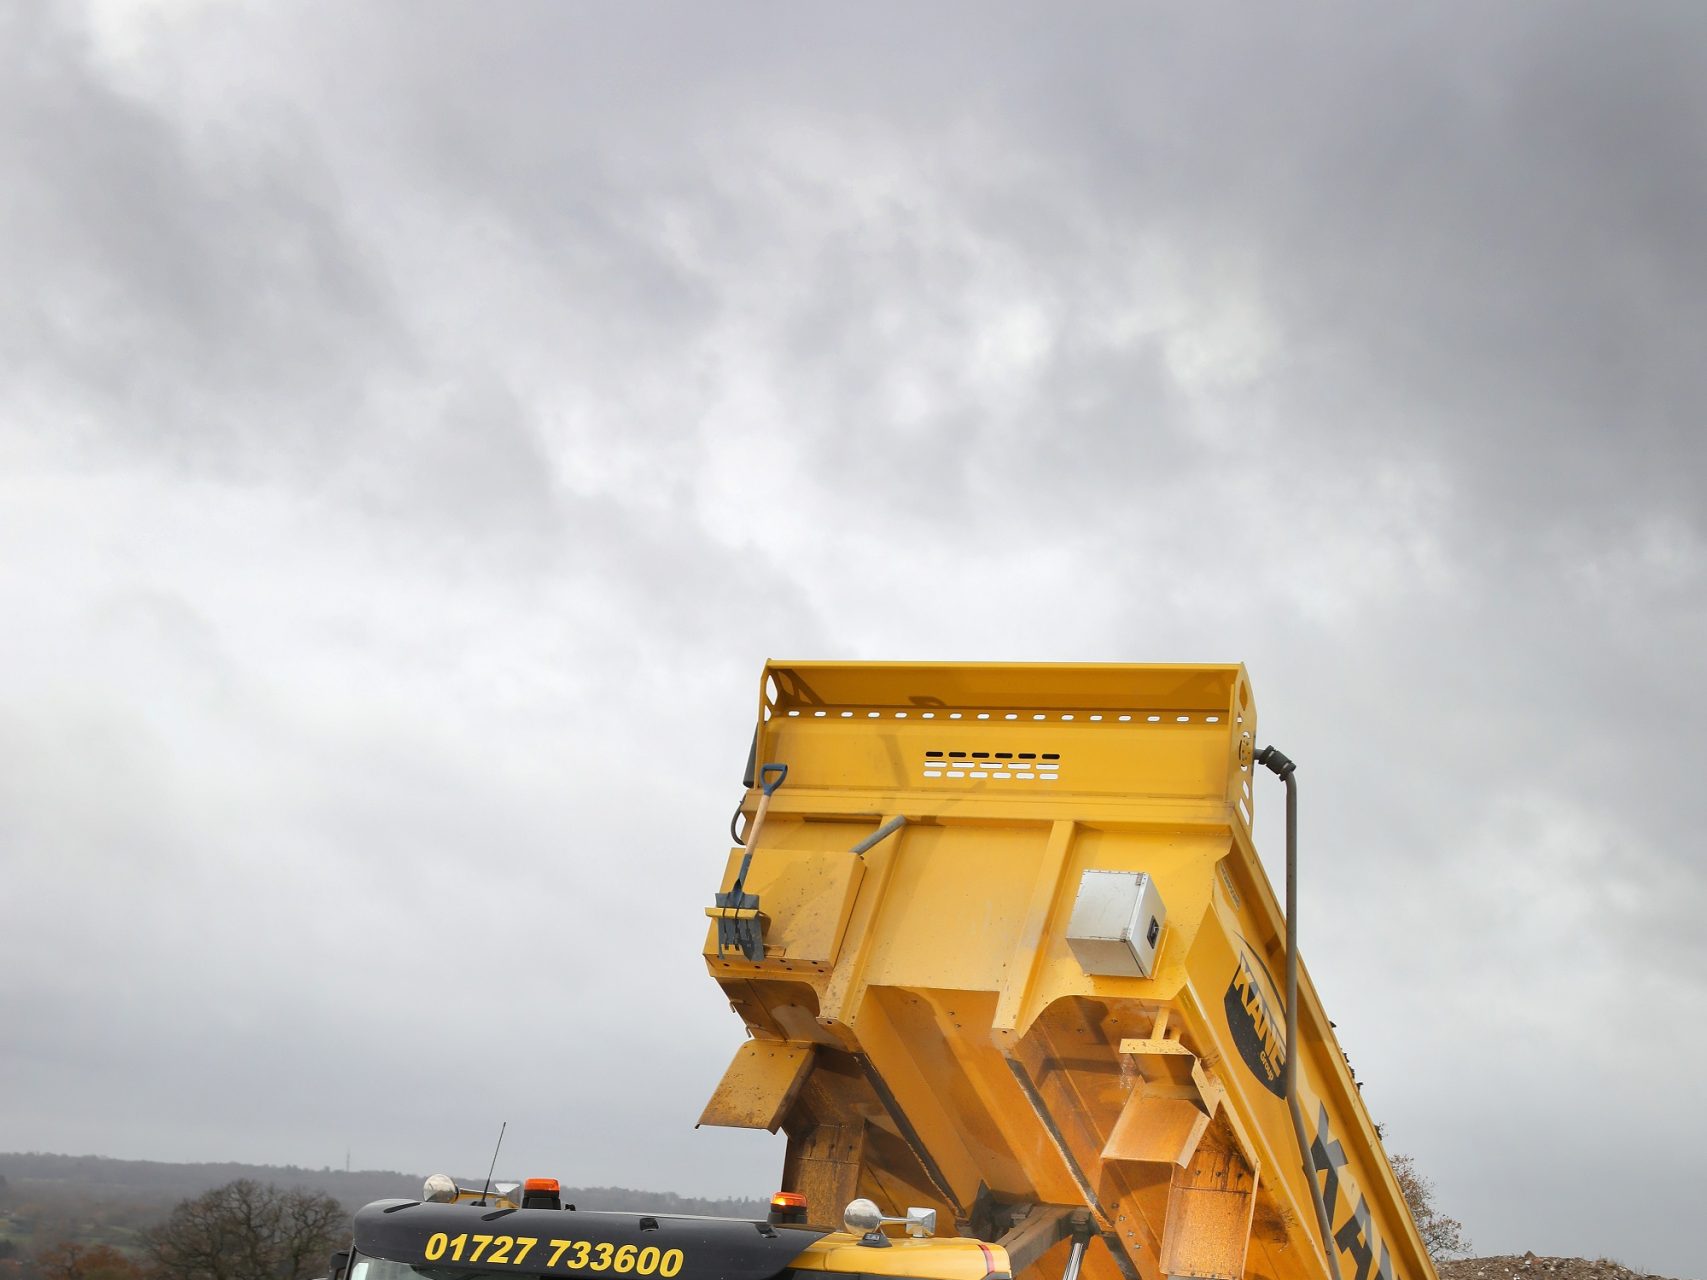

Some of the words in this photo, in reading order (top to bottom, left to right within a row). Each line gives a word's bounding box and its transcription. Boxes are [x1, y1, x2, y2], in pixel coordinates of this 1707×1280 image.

[1233, 956, 1286, 1078] KANE
[1259, 1050, 1274, 1081] Group
[424, 1232, 538, 1265] 01727
[546, 1239, 684, 1278] 733600
